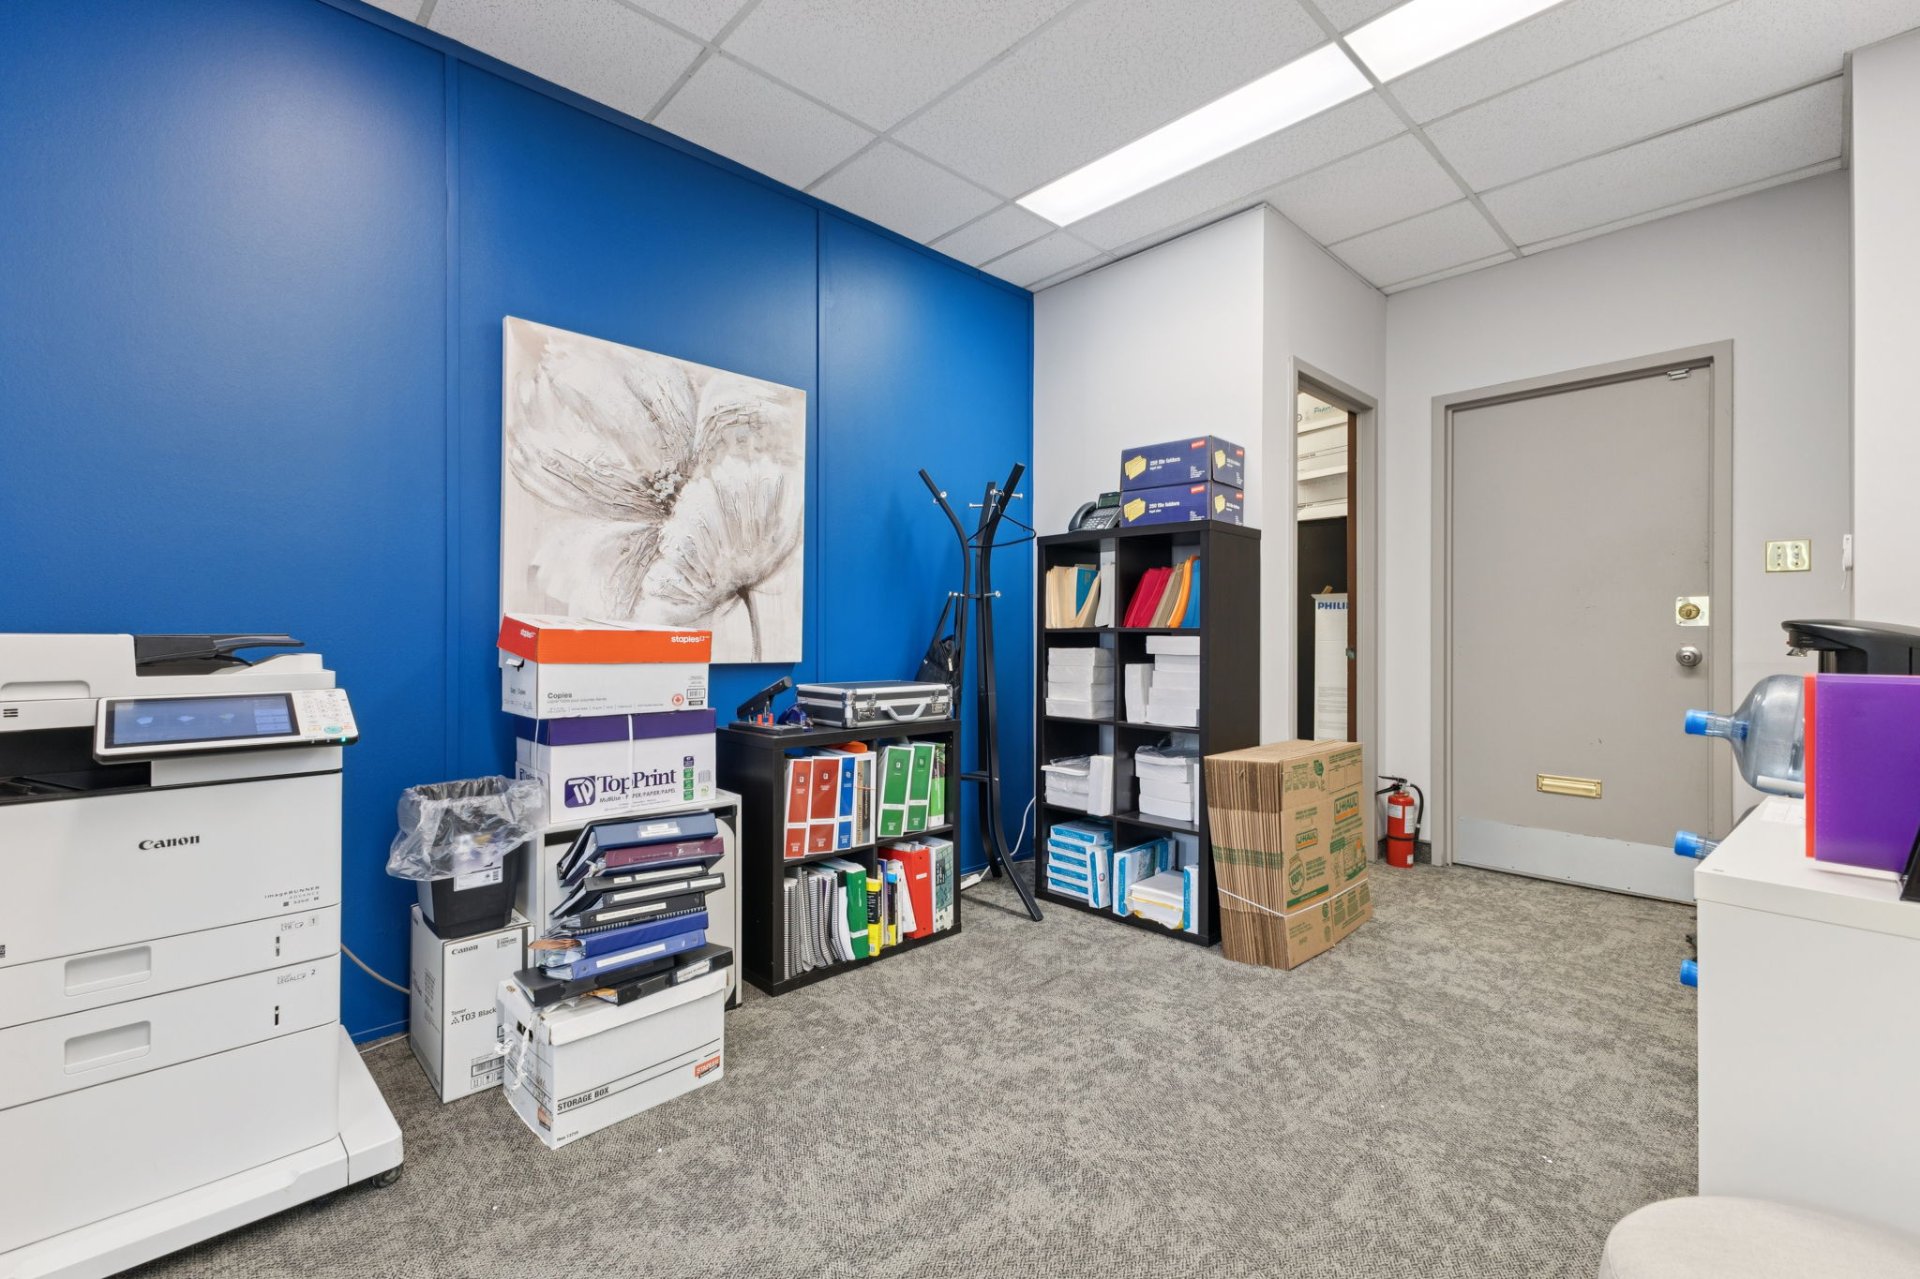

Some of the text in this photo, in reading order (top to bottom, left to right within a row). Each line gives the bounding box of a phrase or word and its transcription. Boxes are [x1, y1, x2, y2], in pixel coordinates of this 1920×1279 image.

[1317, 602, 1349, 610] PHILI
[671, 635, 700, 643] staples
[547, 692, 573, 700] Copies
[138, 835, 200, 851] Canon
[451, 945, 479, 955] Canon
[557, 1087, 609, 1111] STORAGE BOX
